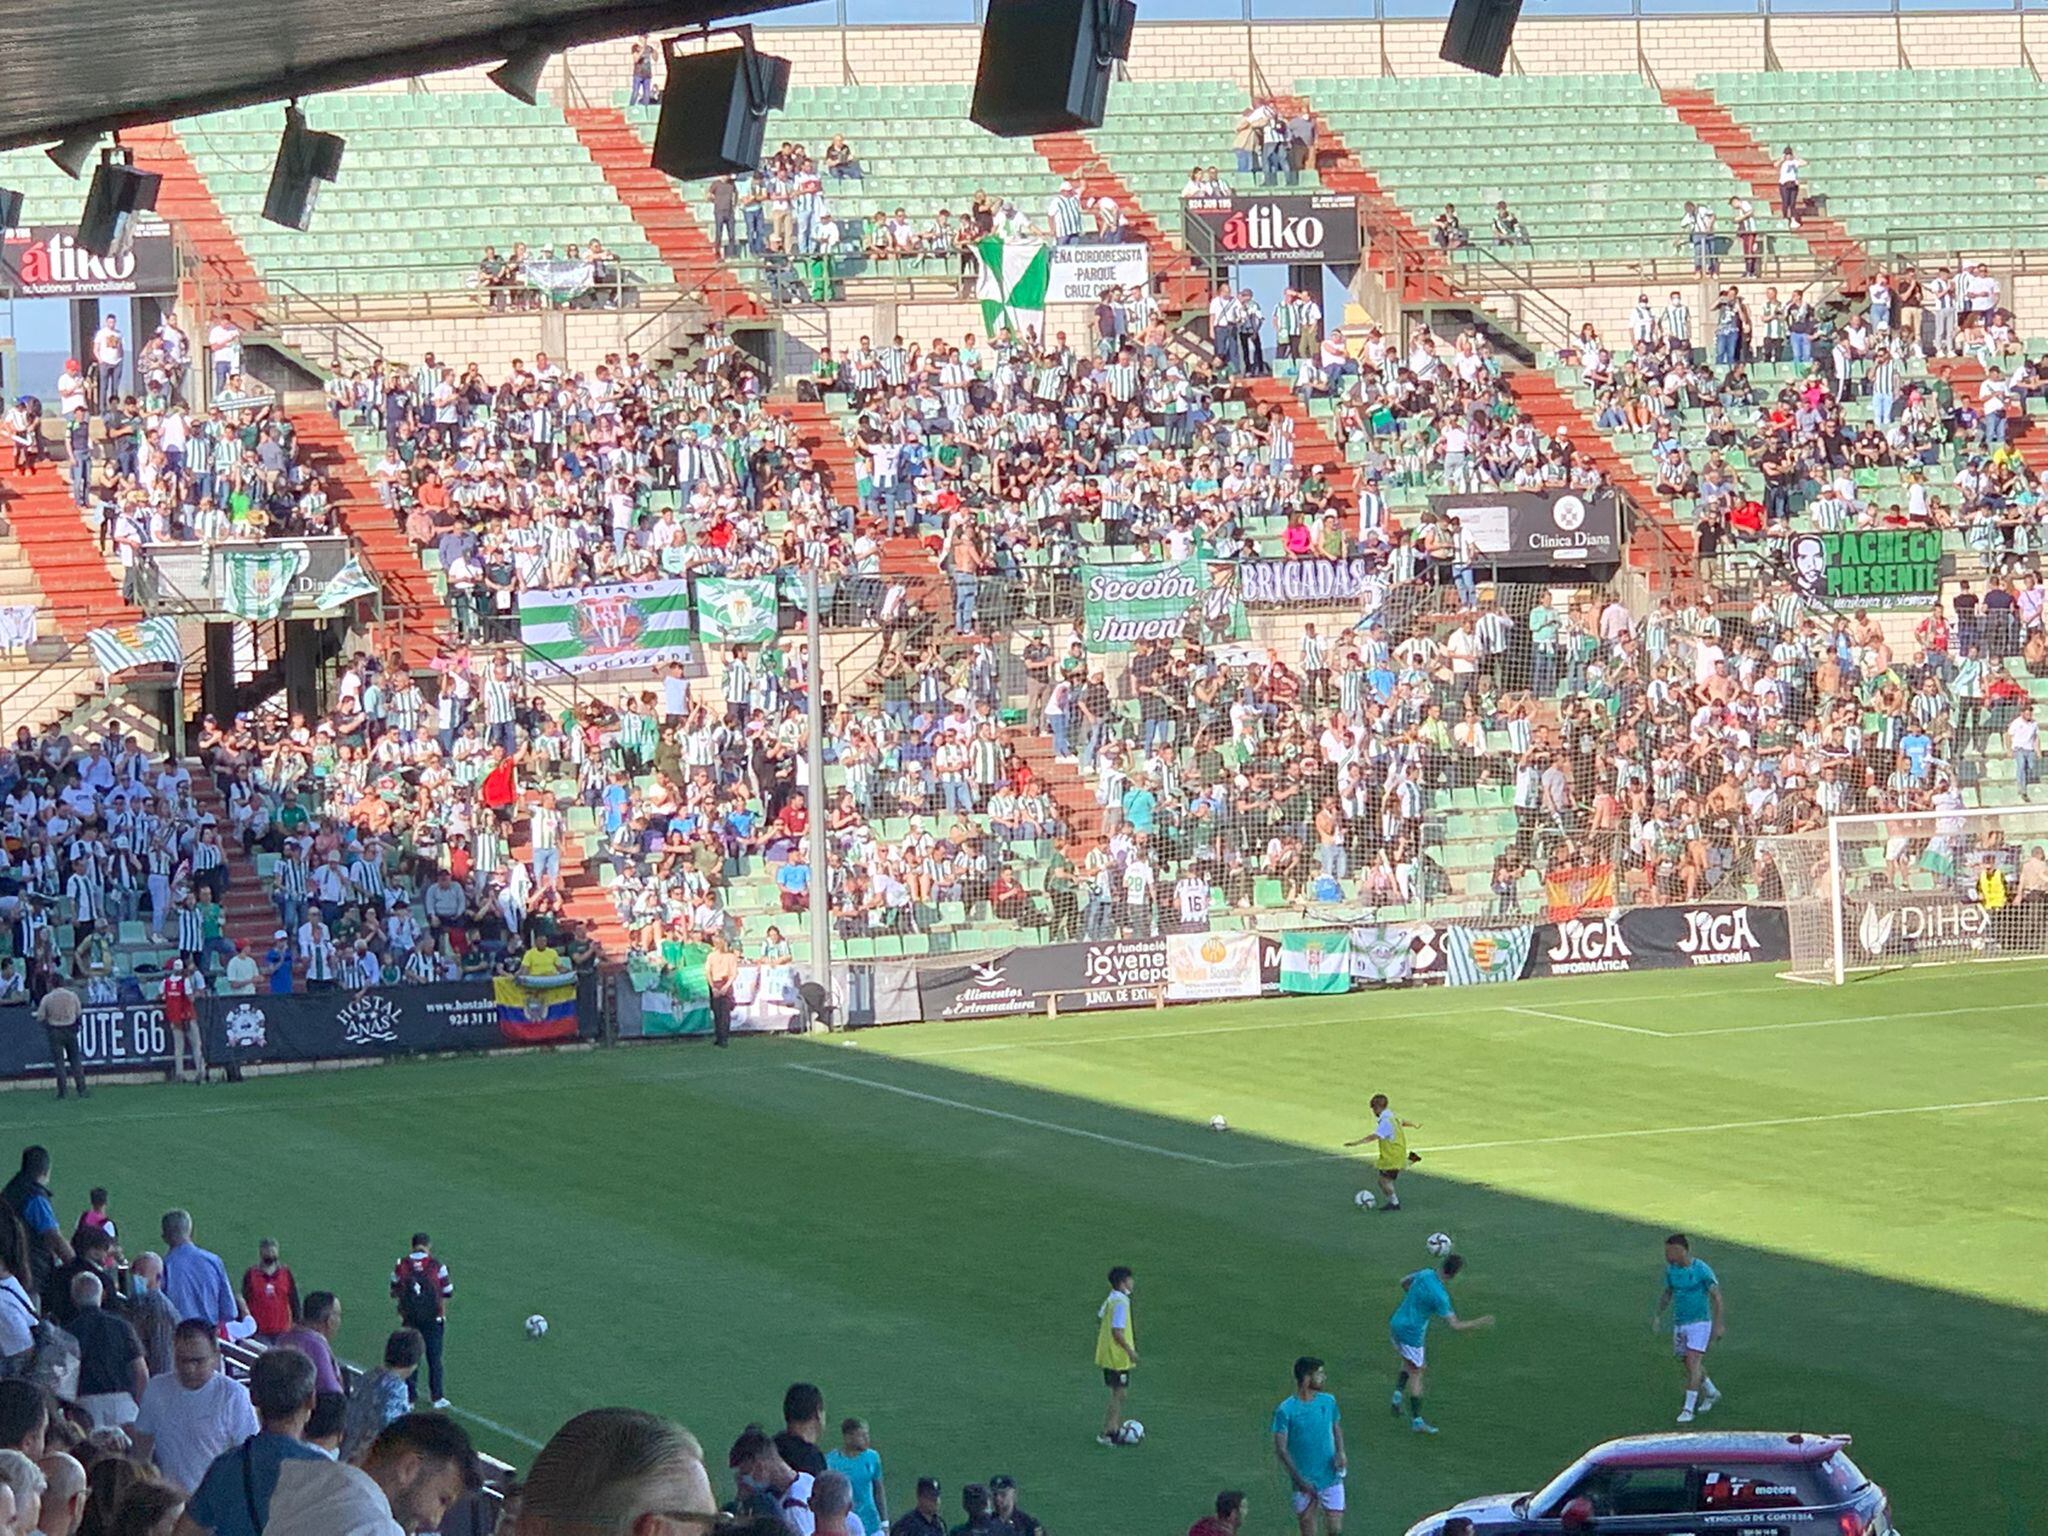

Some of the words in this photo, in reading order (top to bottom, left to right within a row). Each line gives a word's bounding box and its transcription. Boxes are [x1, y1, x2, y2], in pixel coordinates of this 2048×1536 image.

[1222, 203, 1324, 250] átiko
[1075, 249, 1143, 263] CORDOBESISTA
[1064, 284, 1092, 299] CRUZ
[1574, 530, 1611, 546] Diana
[1822, 529, 1943, 567] PACHECO
[1087, 568, 1199, 602] Sección
[1240, 558, 1365, 602] BRIGADAS
[1826, 563, 1940, 596] PRESENTE
[1091, 611, 1190, 644] Juveni
[1188, 896, 1202, 912] 16
[1117, 941, 1168, 955] fundació
[1690, 949, 1752, 965] TELEFONÍA
[1551, 957, 1630, 975] INFORMÁTICA
[956, 987, 1023, 1002] Alimentos
[1085, 991, 1114, 1007] JUNTA
[1116, 989, 1129, 1002] DE
[336, 995, 403, 1026] HOSTAL
[954, 1000, 1036, 1016] Extremadura
[346, 1013, 392, 1035] ANAS
[449, 1012, 469, 1026] 924
[77, 1011, 127, 1058] UTE
[133, 1009, 166, 1055] 66
[1755, 1485, 1798, 1495] motors
